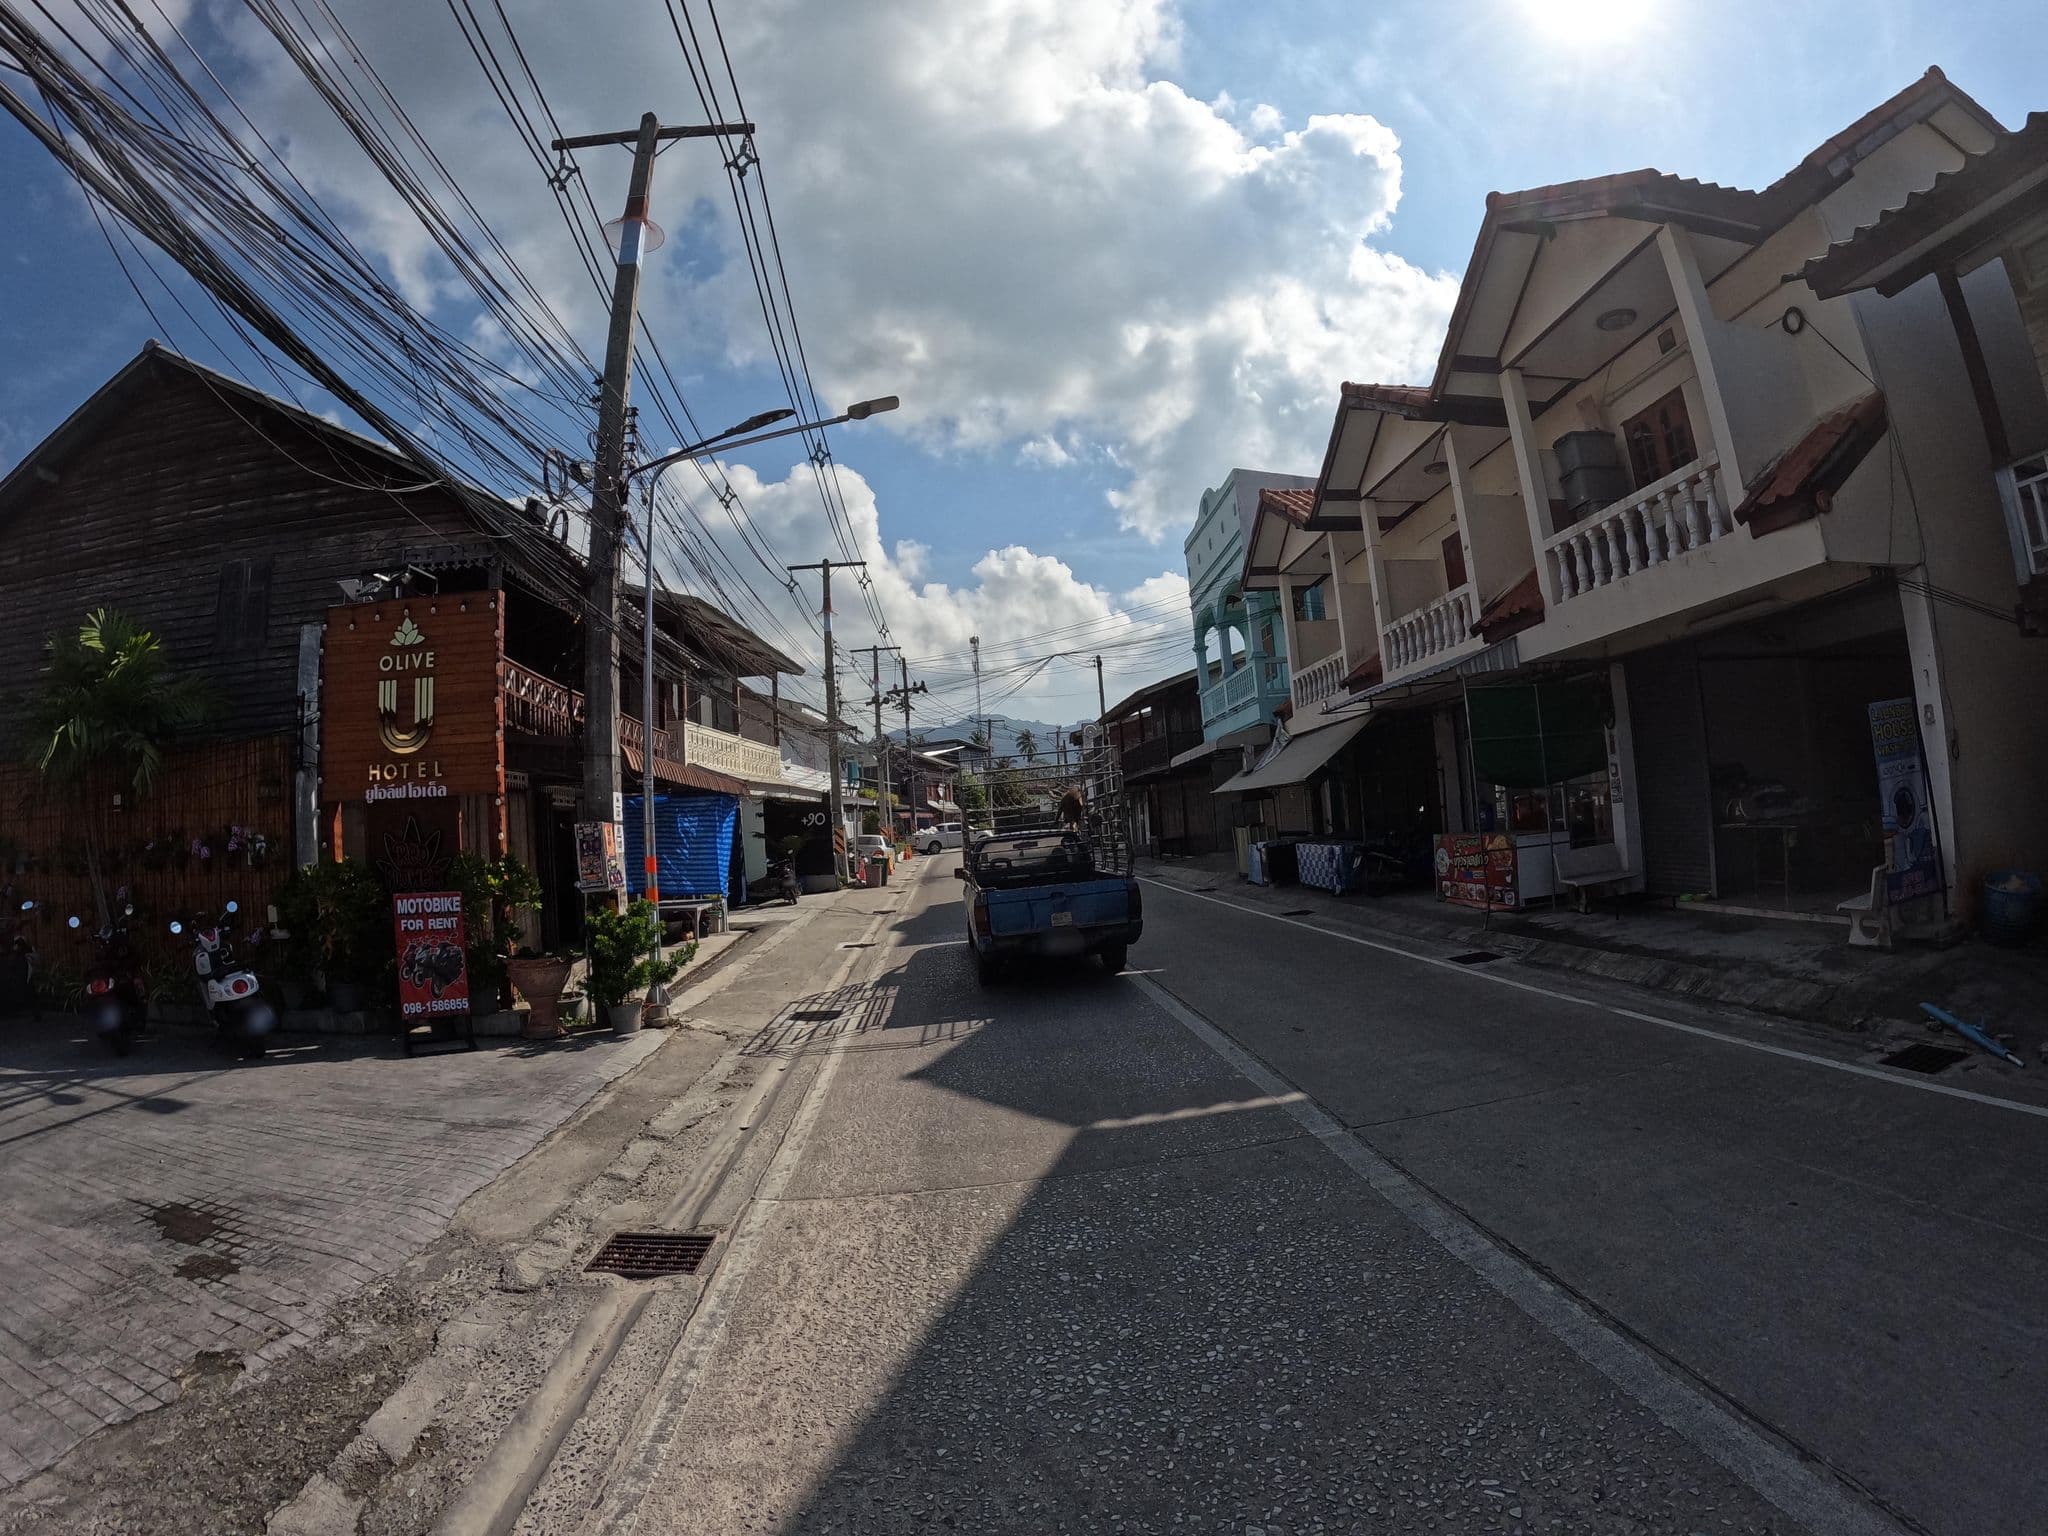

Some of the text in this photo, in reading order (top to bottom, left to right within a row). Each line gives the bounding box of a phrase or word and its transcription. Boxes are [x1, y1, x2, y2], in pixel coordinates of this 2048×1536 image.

[379, 651, 435, 672] OLIVE
[368, 760, 443, 781] HOTEL
[801, 812, 826, 829] +90
[396, 896, 461, 915] MOTOBIKE
[400, 917, 458, 931] FOR RENT
[403, 998, 469, 1014] 098-1586855
